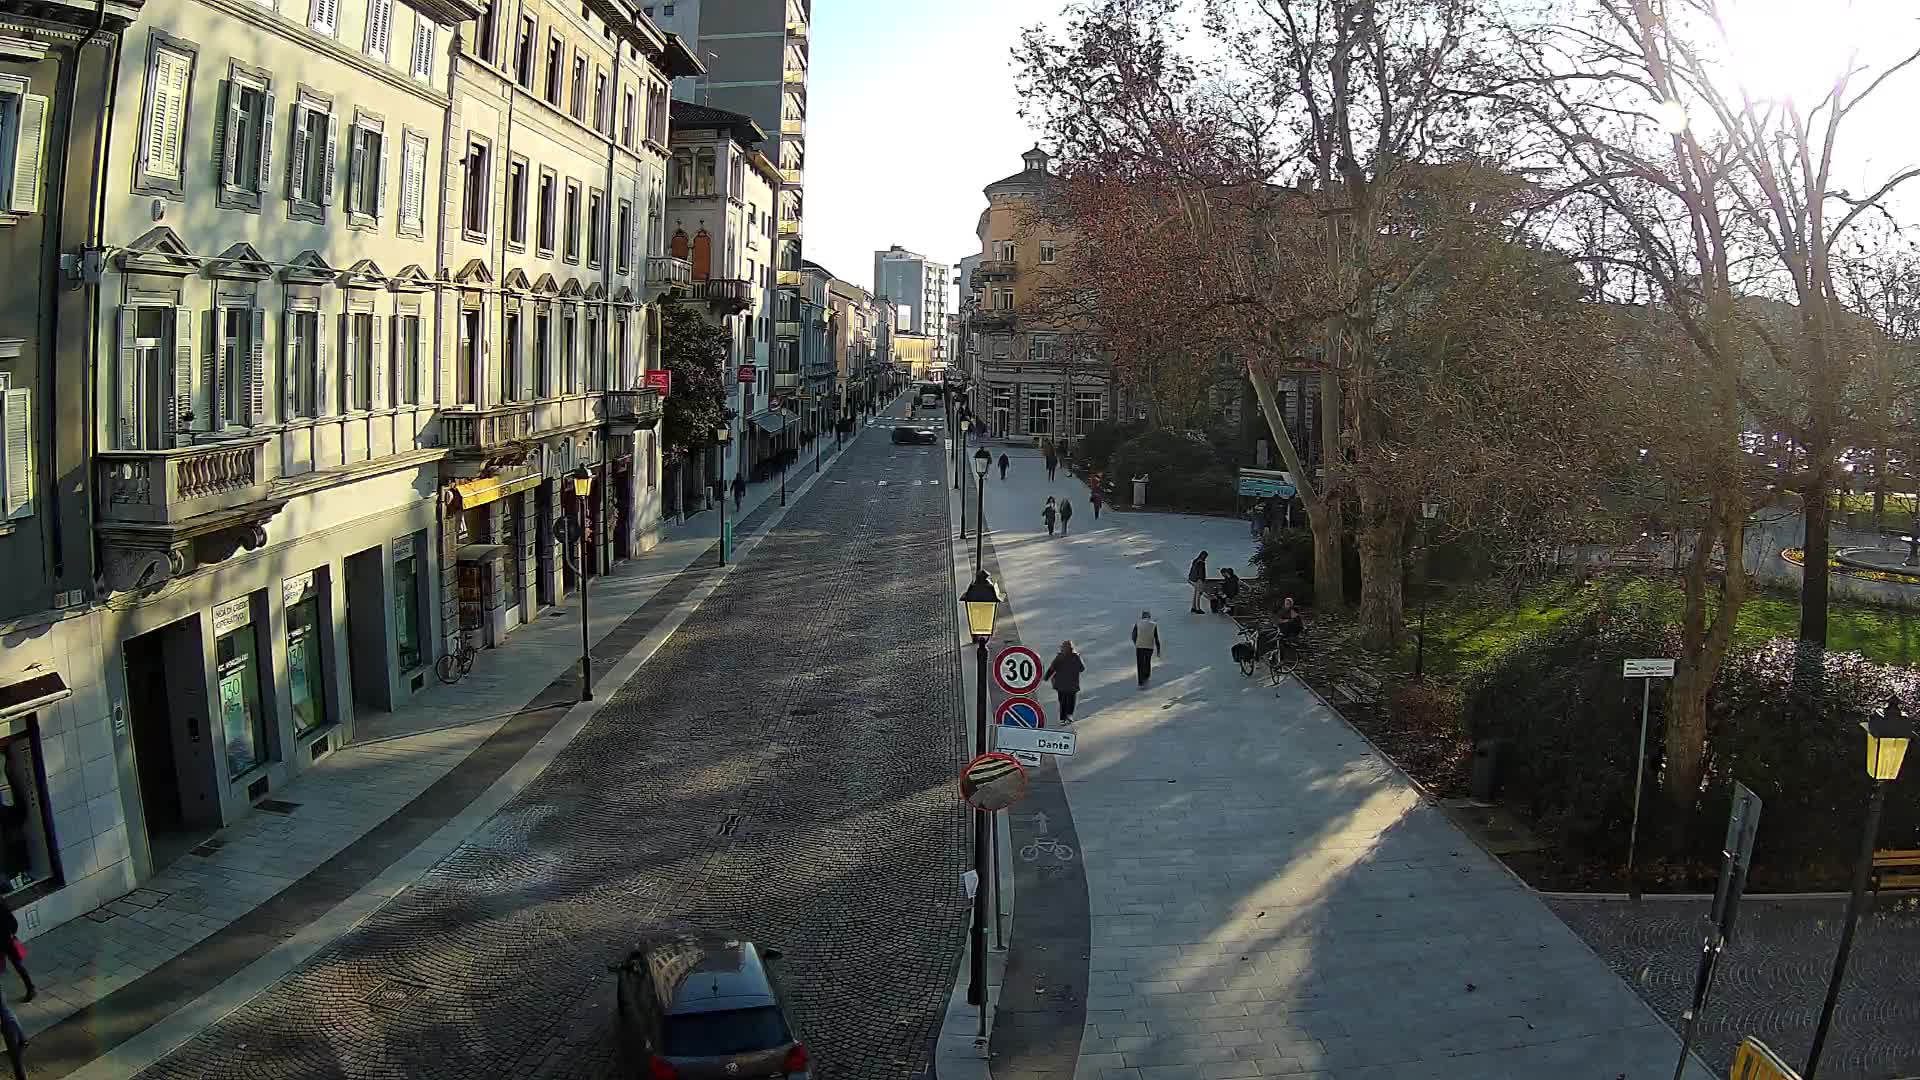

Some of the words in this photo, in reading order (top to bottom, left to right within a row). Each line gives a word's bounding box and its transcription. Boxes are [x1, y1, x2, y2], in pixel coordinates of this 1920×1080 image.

[1005, 659, 1033, 681] 30
[221, 679, 240, 701] 130
[1038, 739, 1069, 750] Dante
